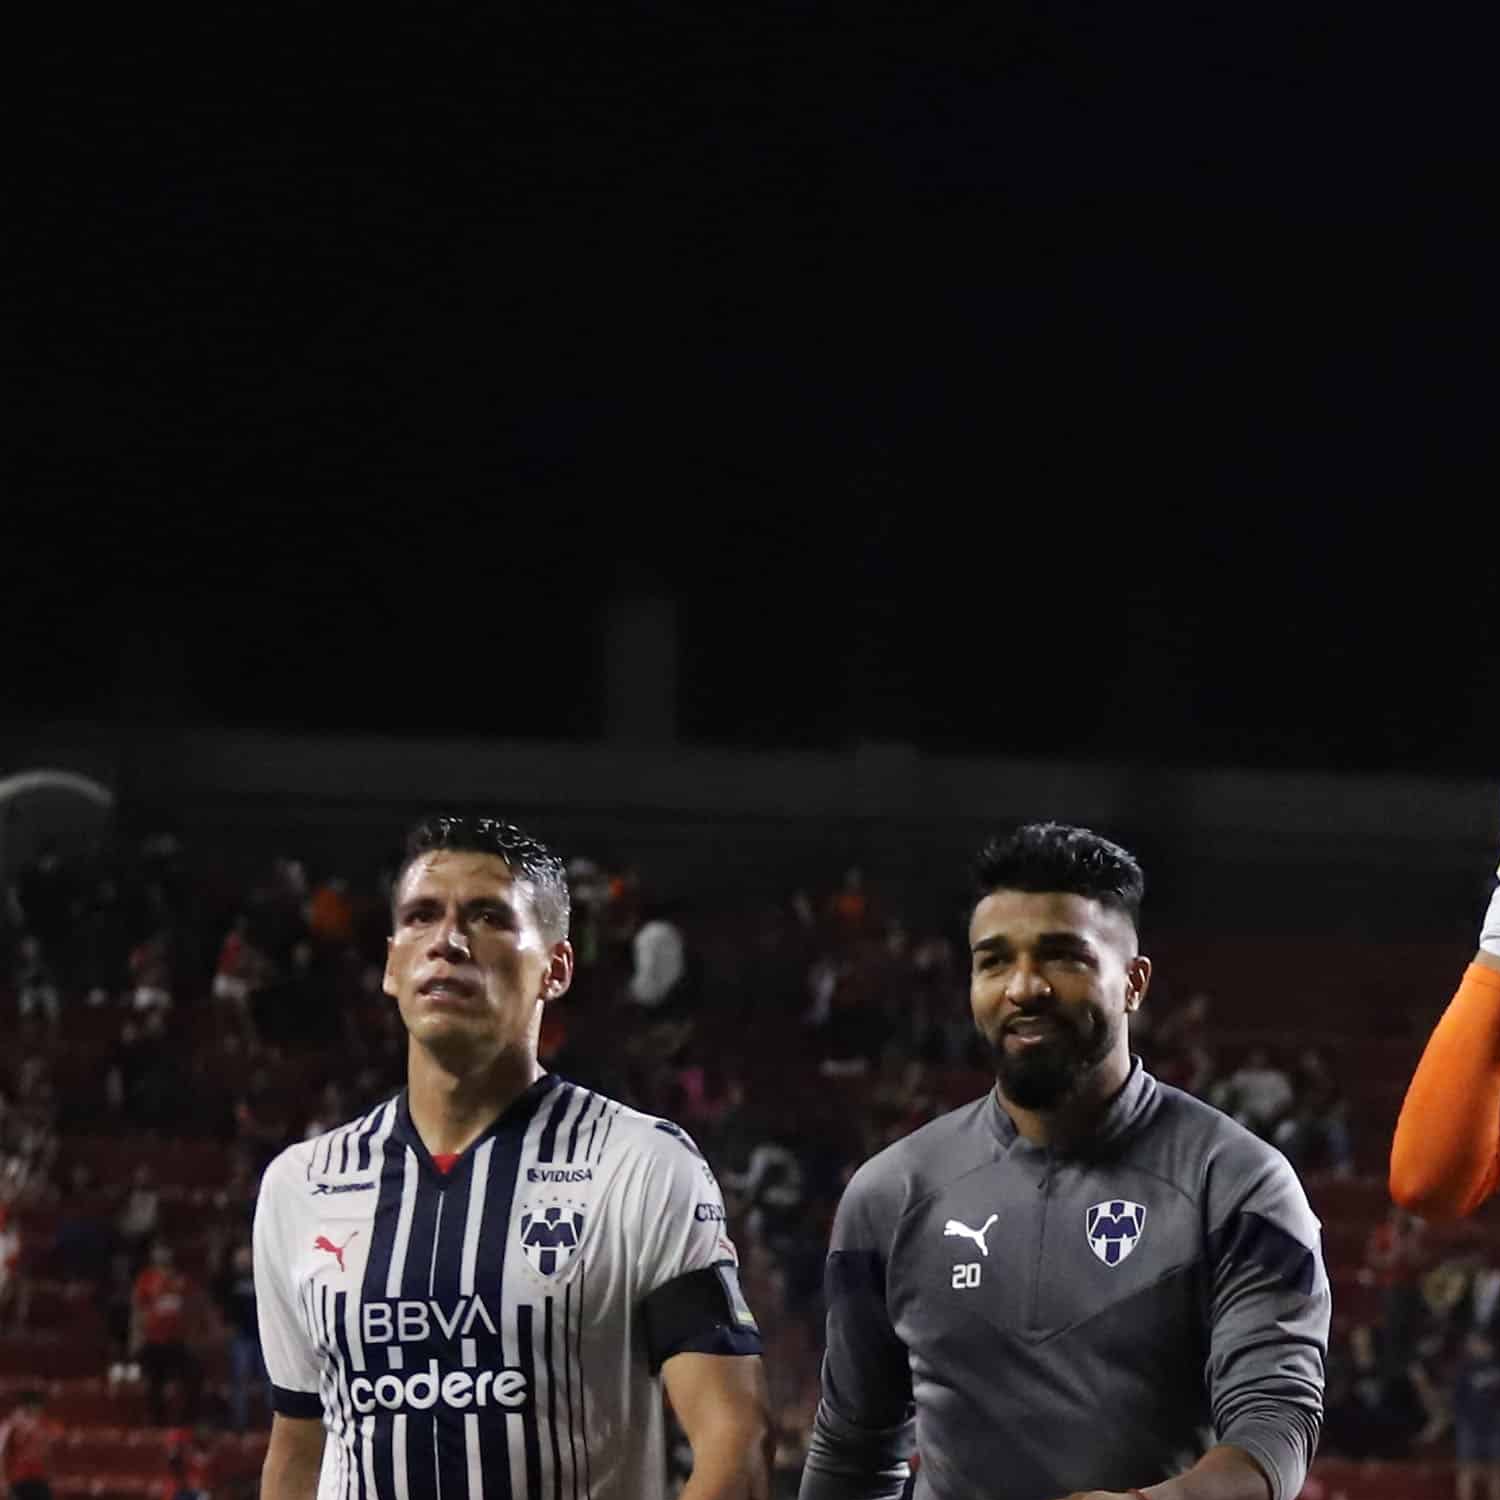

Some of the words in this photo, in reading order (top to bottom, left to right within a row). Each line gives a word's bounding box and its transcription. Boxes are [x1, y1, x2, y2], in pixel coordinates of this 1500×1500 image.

[540, 1167, 592, 1183] VIDUSA
[951, 1262, 981, 1289] 20
[362, 1293, 498, 1345] BBVA
[350, 1359, 528, 1412] codere
